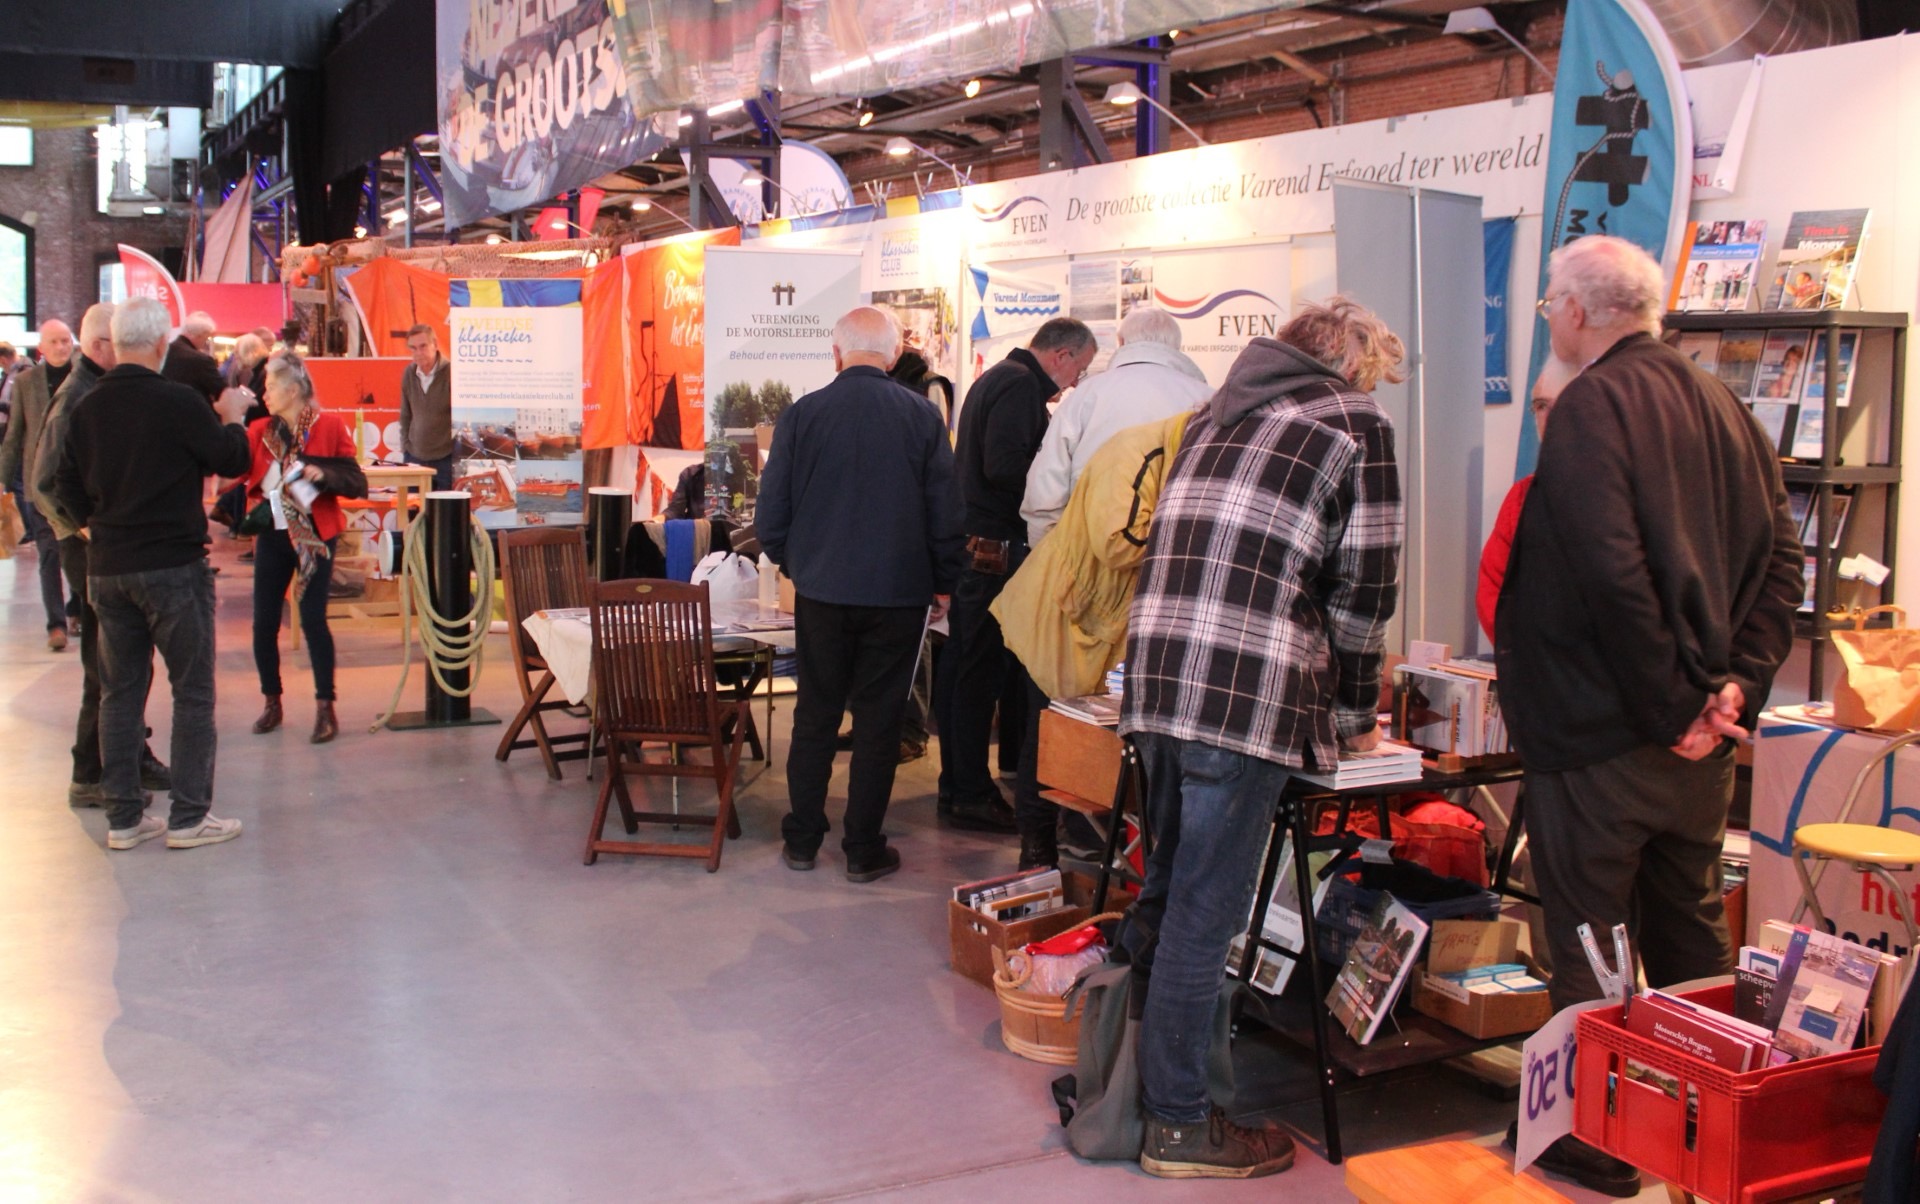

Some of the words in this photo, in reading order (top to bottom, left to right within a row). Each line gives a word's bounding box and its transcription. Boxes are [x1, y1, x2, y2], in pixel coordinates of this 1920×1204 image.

[495, 16, 627, 153] GROOTS
[1066, 197, 1089, 221] De
[1093, 195, 1153, 224] grootste
[1162, 179, 1232, 211] collectie
[1239, 165, 1311, 199] Varend
[1316, 151, 1405, 191] Efoed
[1409, 155, 1445, 181] ter
[1452, 133, 1545, 176] wereld
[1013, 213, 1049, 235] FVEN
[1798, 240, 1846, 256] Money
[881, 258, 902, 272] CLUB
[994, 292, 1018, 303] Varend
[1021, 292, 1062, 303] Monument
[458, 317, 534, 331] ZWEEDSE
[752, 314, 820, 325] VERENIGING
[1218, 314, 1277, 336] FVEN
[458, 325, 533, 344] klassieker
[726, 328, 740, 337] DE
[458, 345, 498, 358] CLUB
[729, 351, 765, 360] Behoud
[767, 352, 778, 360] en
[458, 391, 574, 401] www.zweedseklassiekerclub.nl
